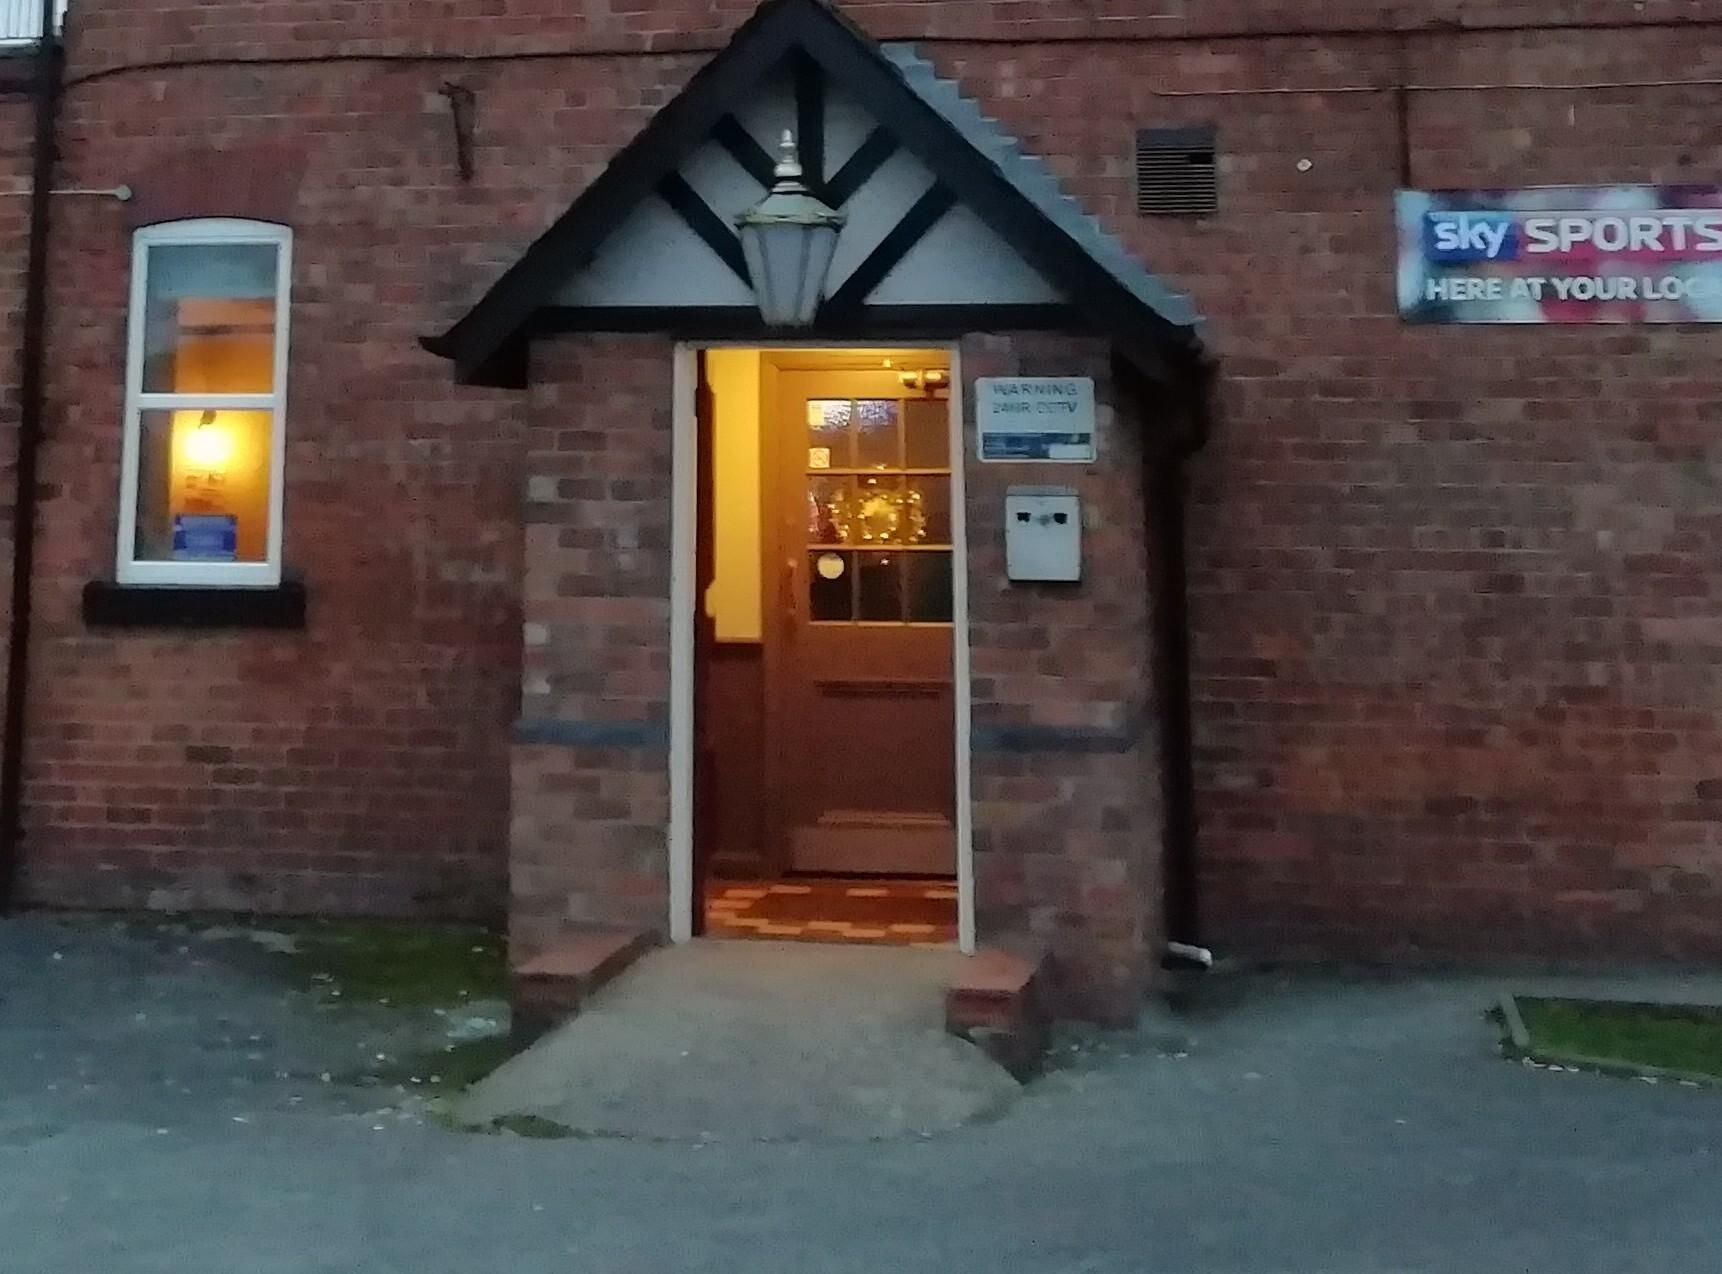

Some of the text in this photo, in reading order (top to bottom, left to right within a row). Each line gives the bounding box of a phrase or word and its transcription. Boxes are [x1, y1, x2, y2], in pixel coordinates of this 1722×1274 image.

[1434, 213, 1722, 258] sky SPORTS
[1427, 277, 1502, 300] HERE
[1510, 277, 1545, 301] AT
[1552, 275, 1638, 300] YOUR
[993, 383, 1078, 396] WARNING
[1036, 401, 1078, 414] CCTV
